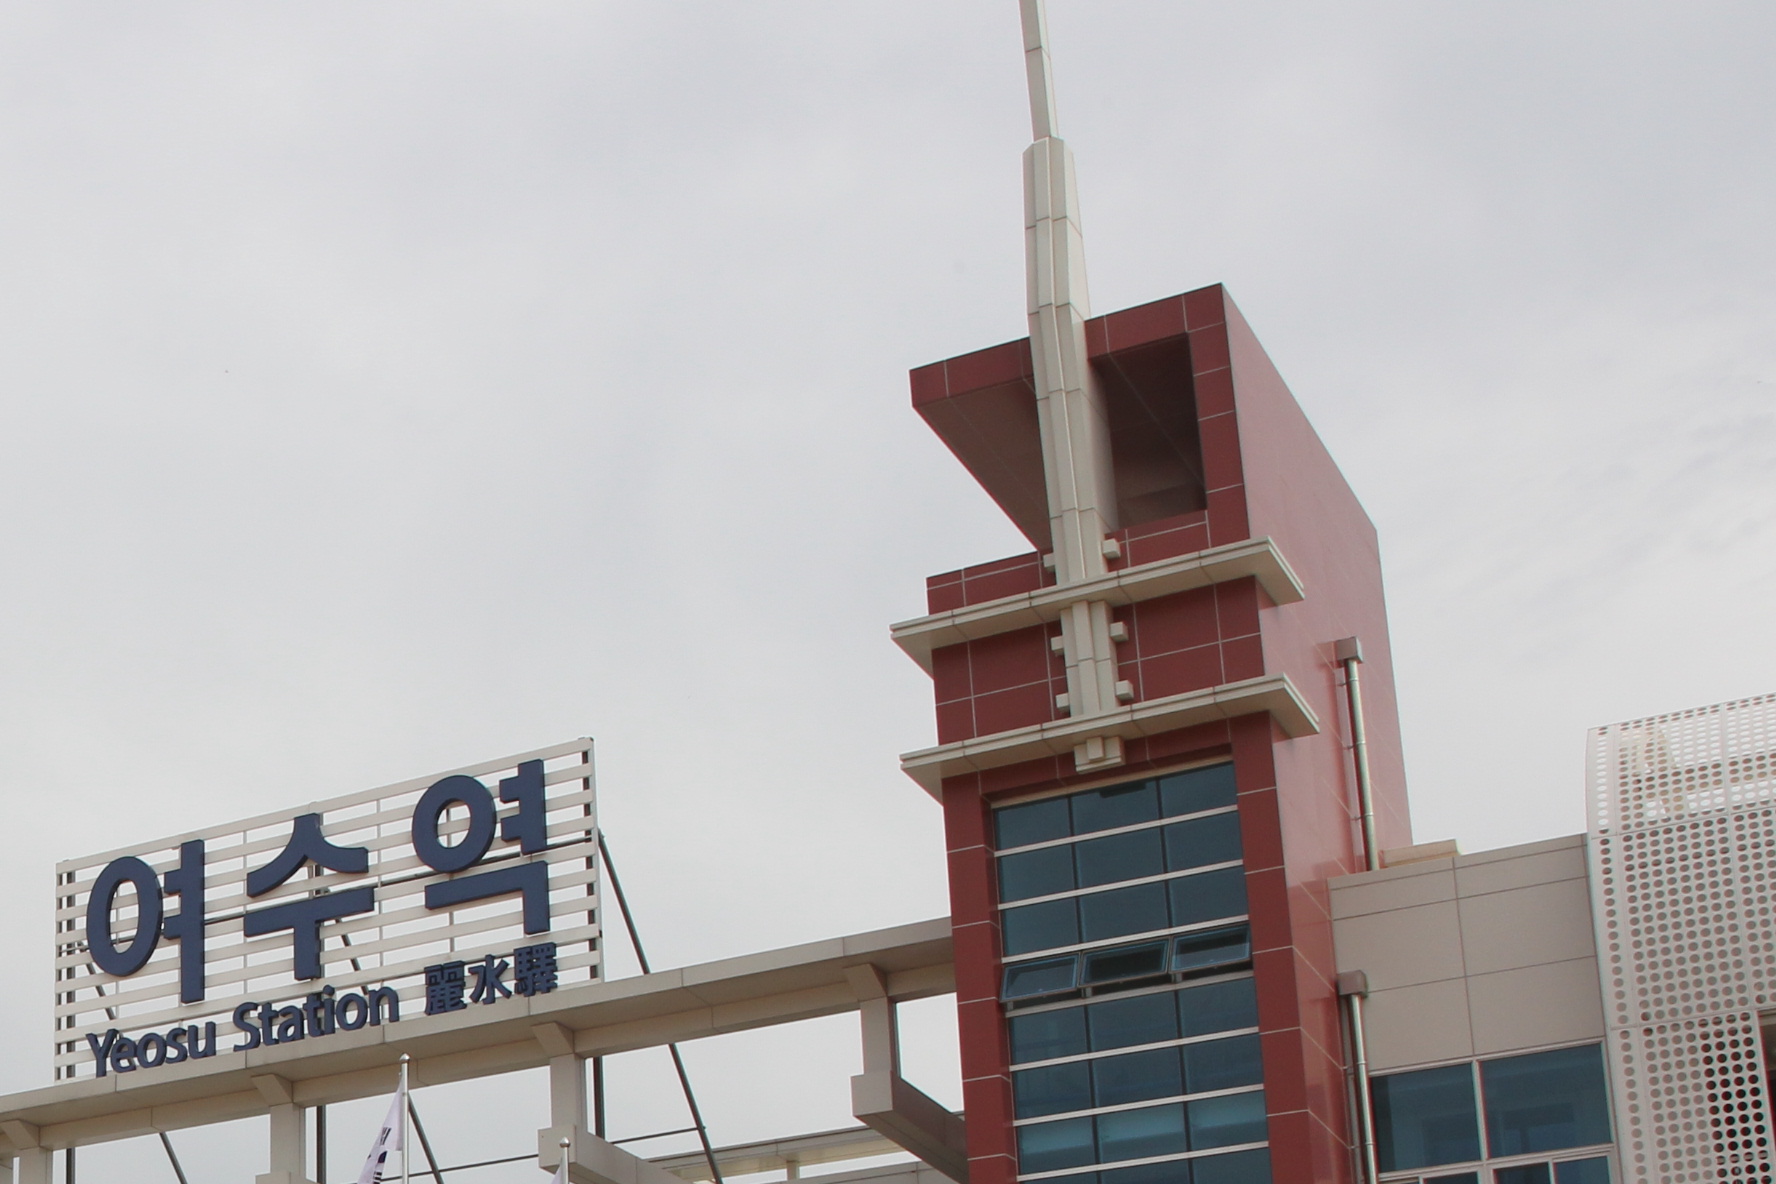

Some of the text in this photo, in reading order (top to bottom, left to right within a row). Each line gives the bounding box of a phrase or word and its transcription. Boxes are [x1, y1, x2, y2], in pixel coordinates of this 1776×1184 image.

[86, 758, 550, 1004] 여수역
[85, 984, 400, 1077] Yeosu Station
